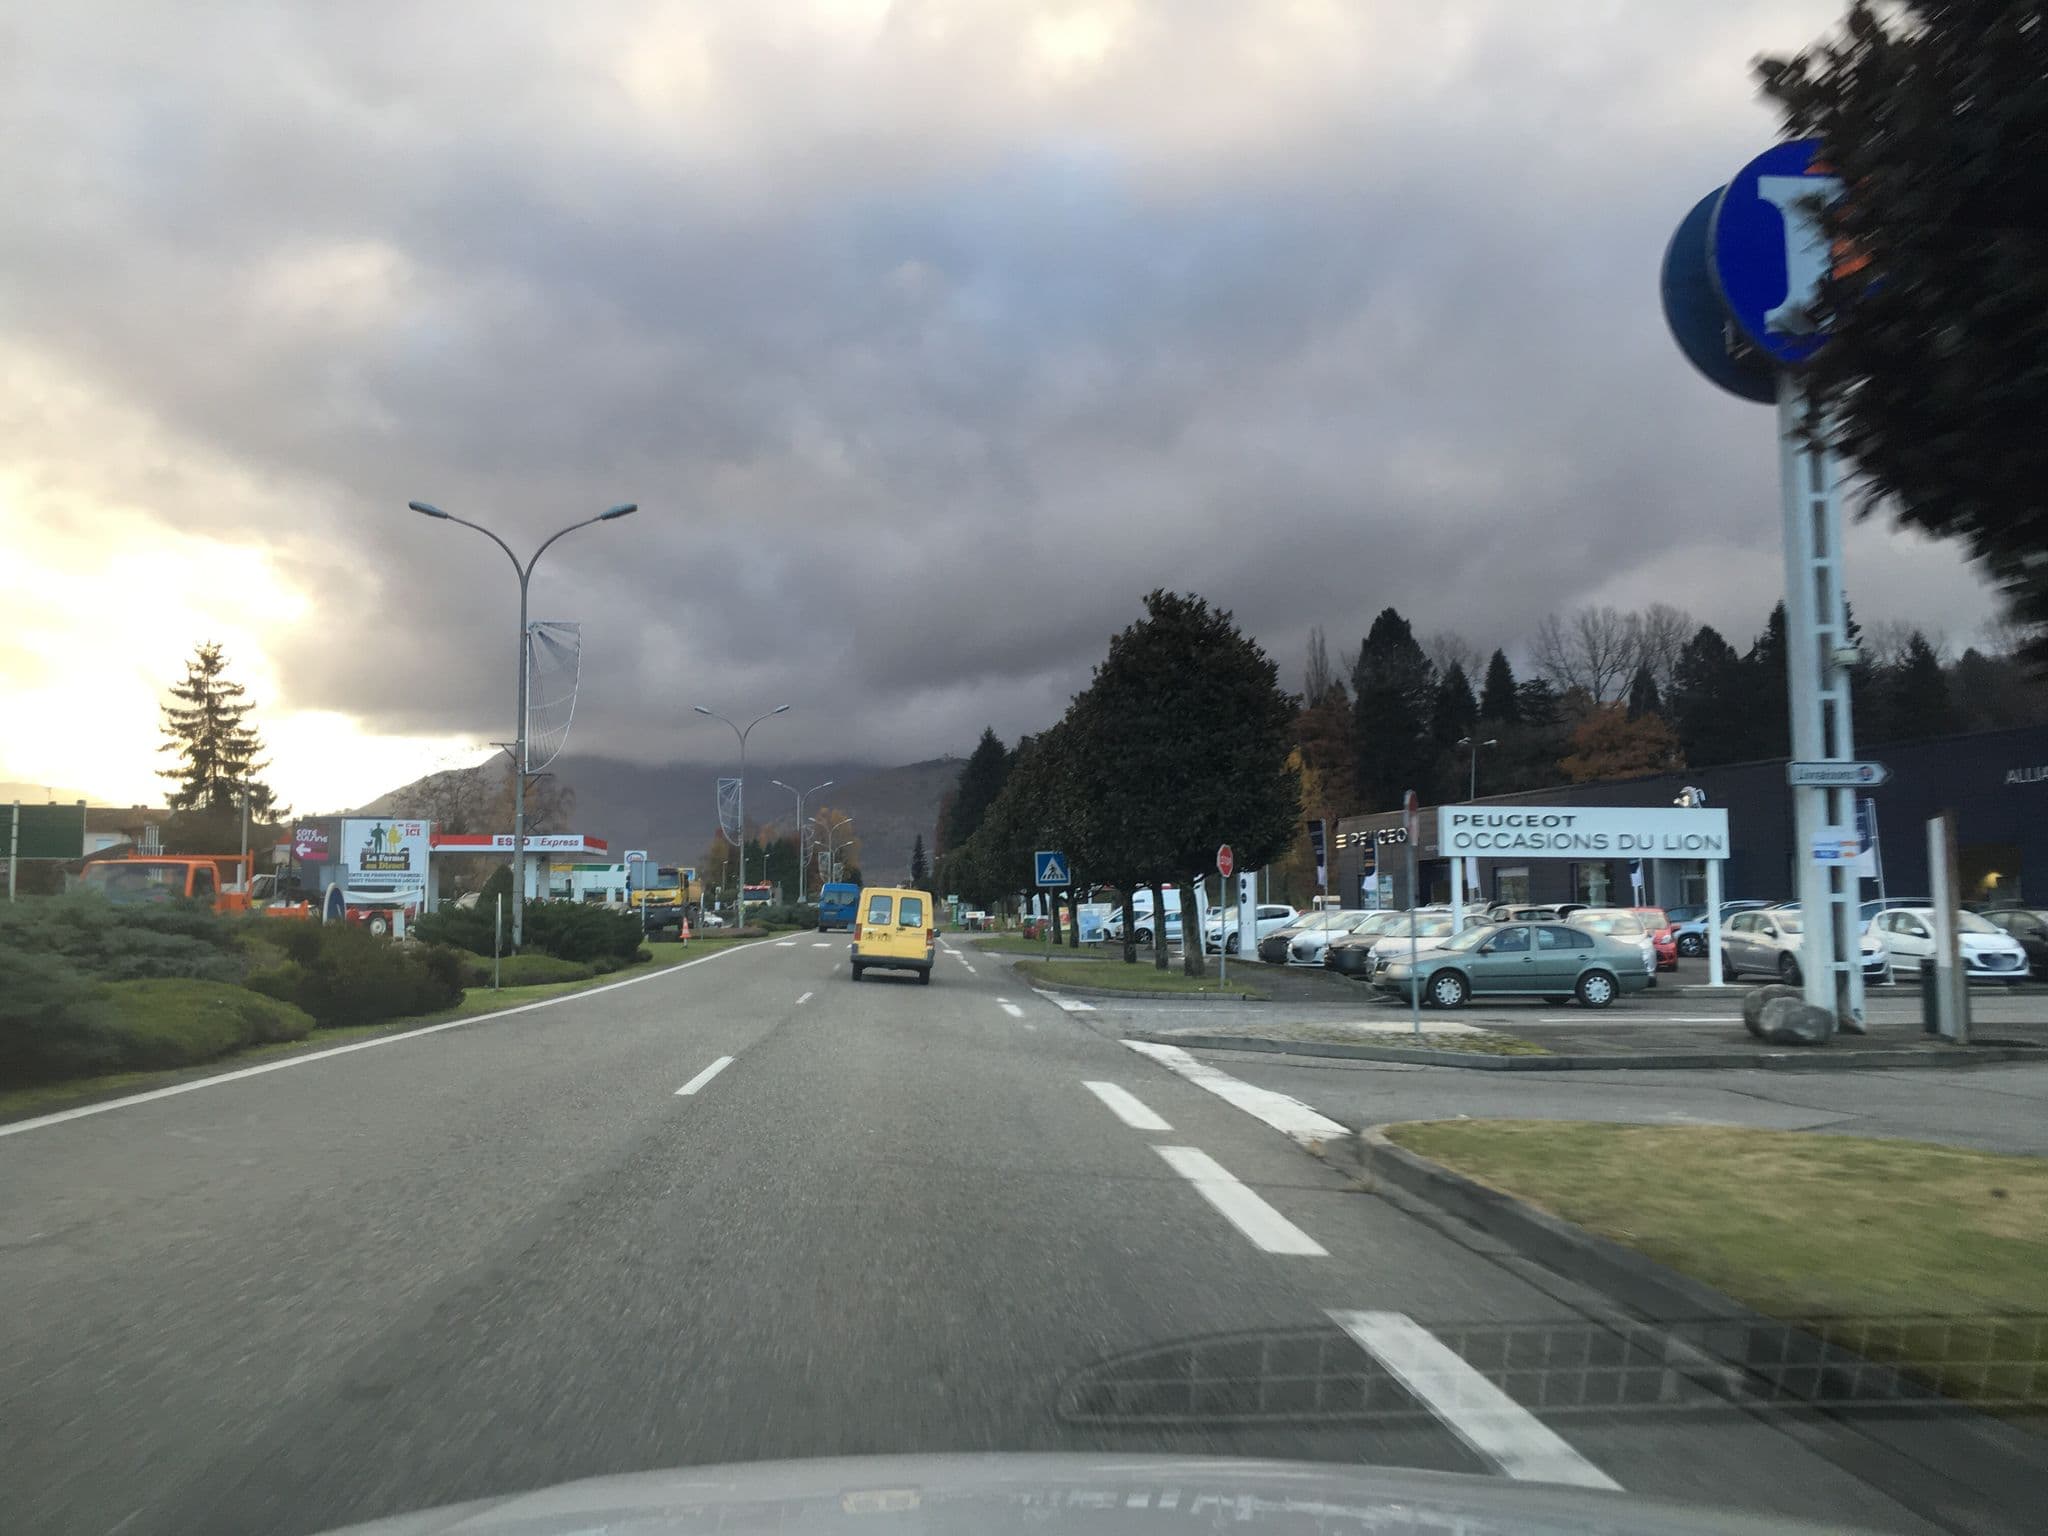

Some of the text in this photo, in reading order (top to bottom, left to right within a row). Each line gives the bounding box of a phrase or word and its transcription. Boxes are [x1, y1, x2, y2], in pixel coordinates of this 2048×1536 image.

[1453, 814, 1577, 828] PEUGEOT
[405, 828, 421, 836] ICI
[1350, 827, 1410, 846] PEGEO
[497, 837, 579, 847] ESO Express
[1454, 832, 1723, 850] OCCASIONS DU LION
